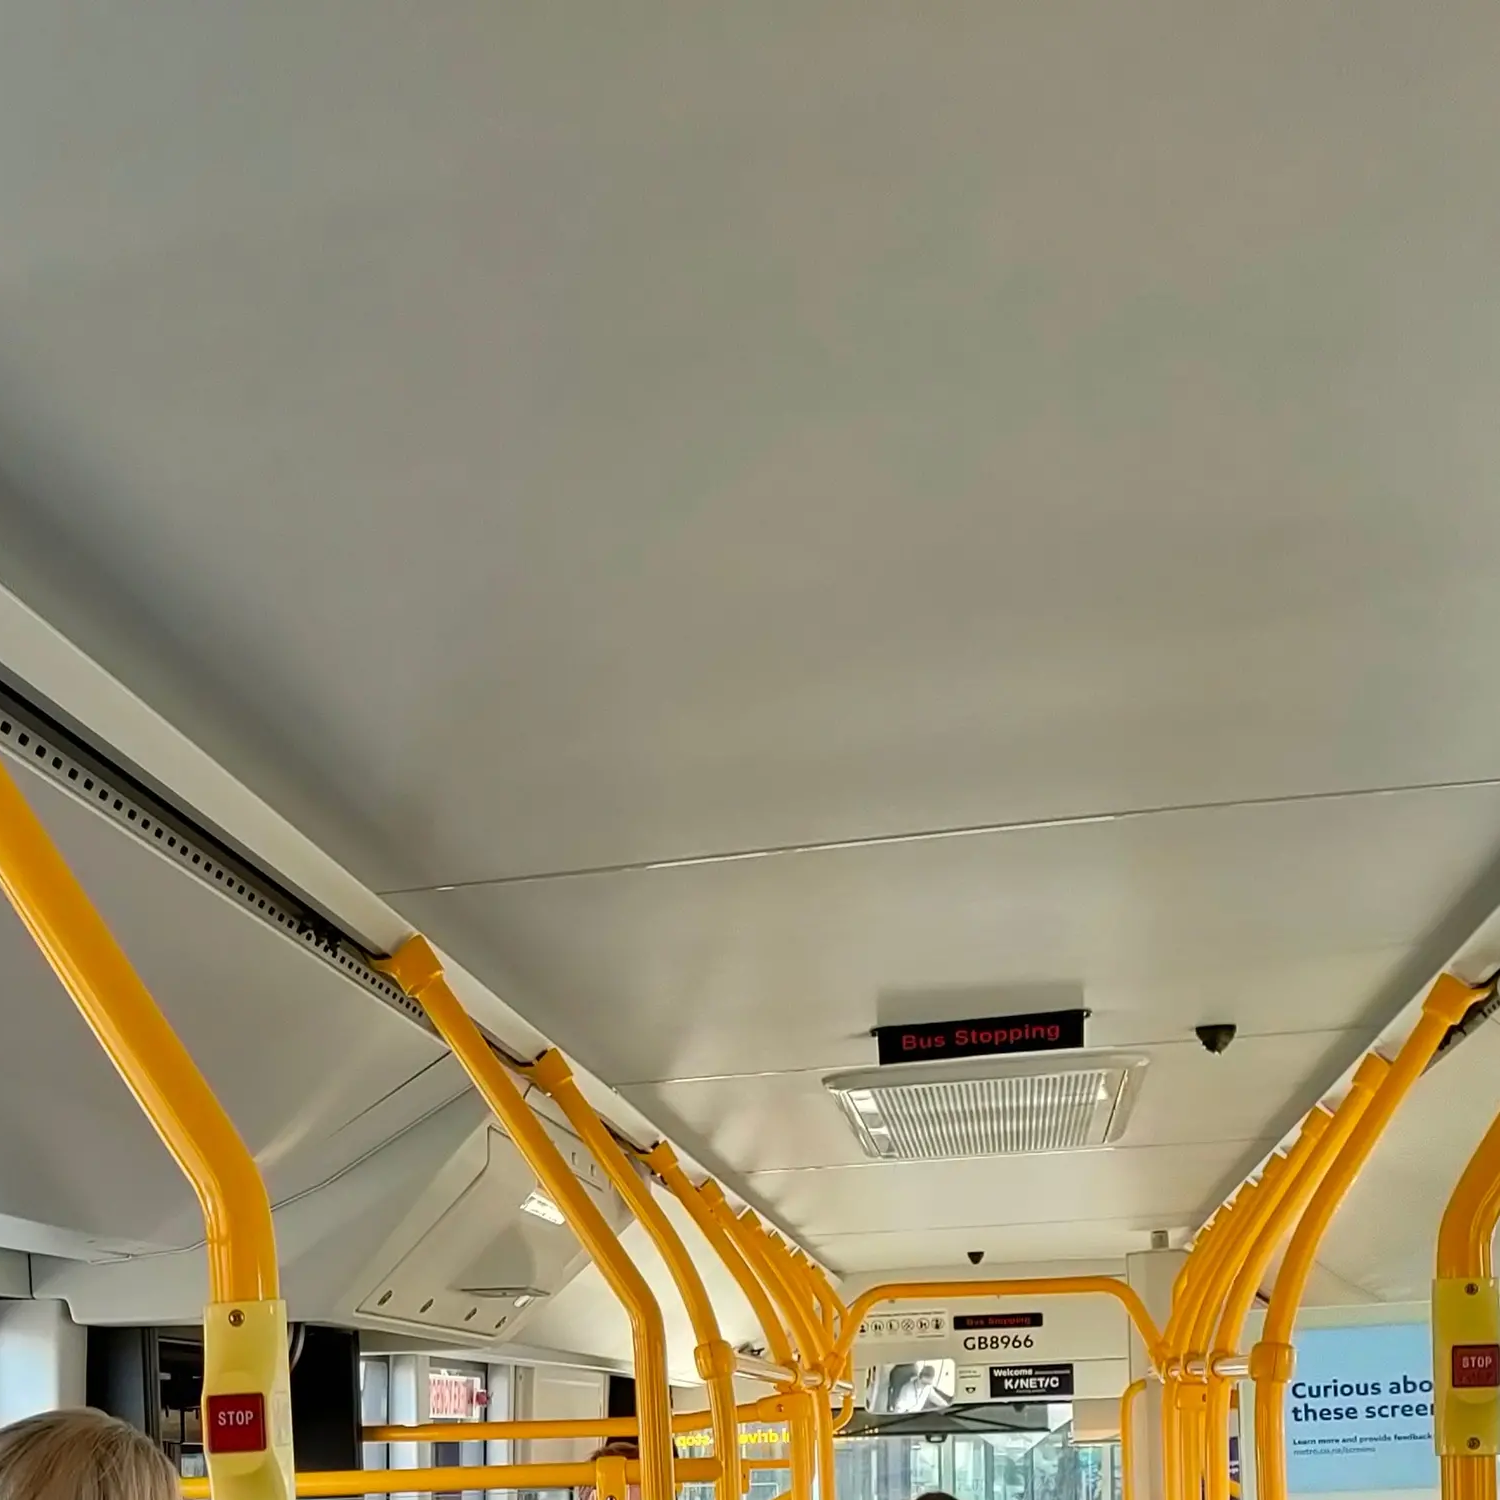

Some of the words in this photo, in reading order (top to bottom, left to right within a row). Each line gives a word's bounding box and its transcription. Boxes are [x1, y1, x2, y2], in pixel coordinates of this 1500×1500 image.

[902, 1034, 945, 1050] Bus
[955, 1024, 1060, 1046] Stopping
[963, 1334, 1034, 1350] GB8966
[1462, 1356, 1492, 1368] STOP
[993, 1368, 1033, 1377] Welcome
[1291, 1379, 1381, 1399] Curious
[1389, 1375, 1433, 1394] abo
[218, 1410, 254, 1426] STOP
[1292, 1403, 1358, 1422] these
[1341, 1435, 1357, 1443] and
[1359, 1434, 1392, 1444] provide
[1394, 1433, 1432, 1442] feedback
